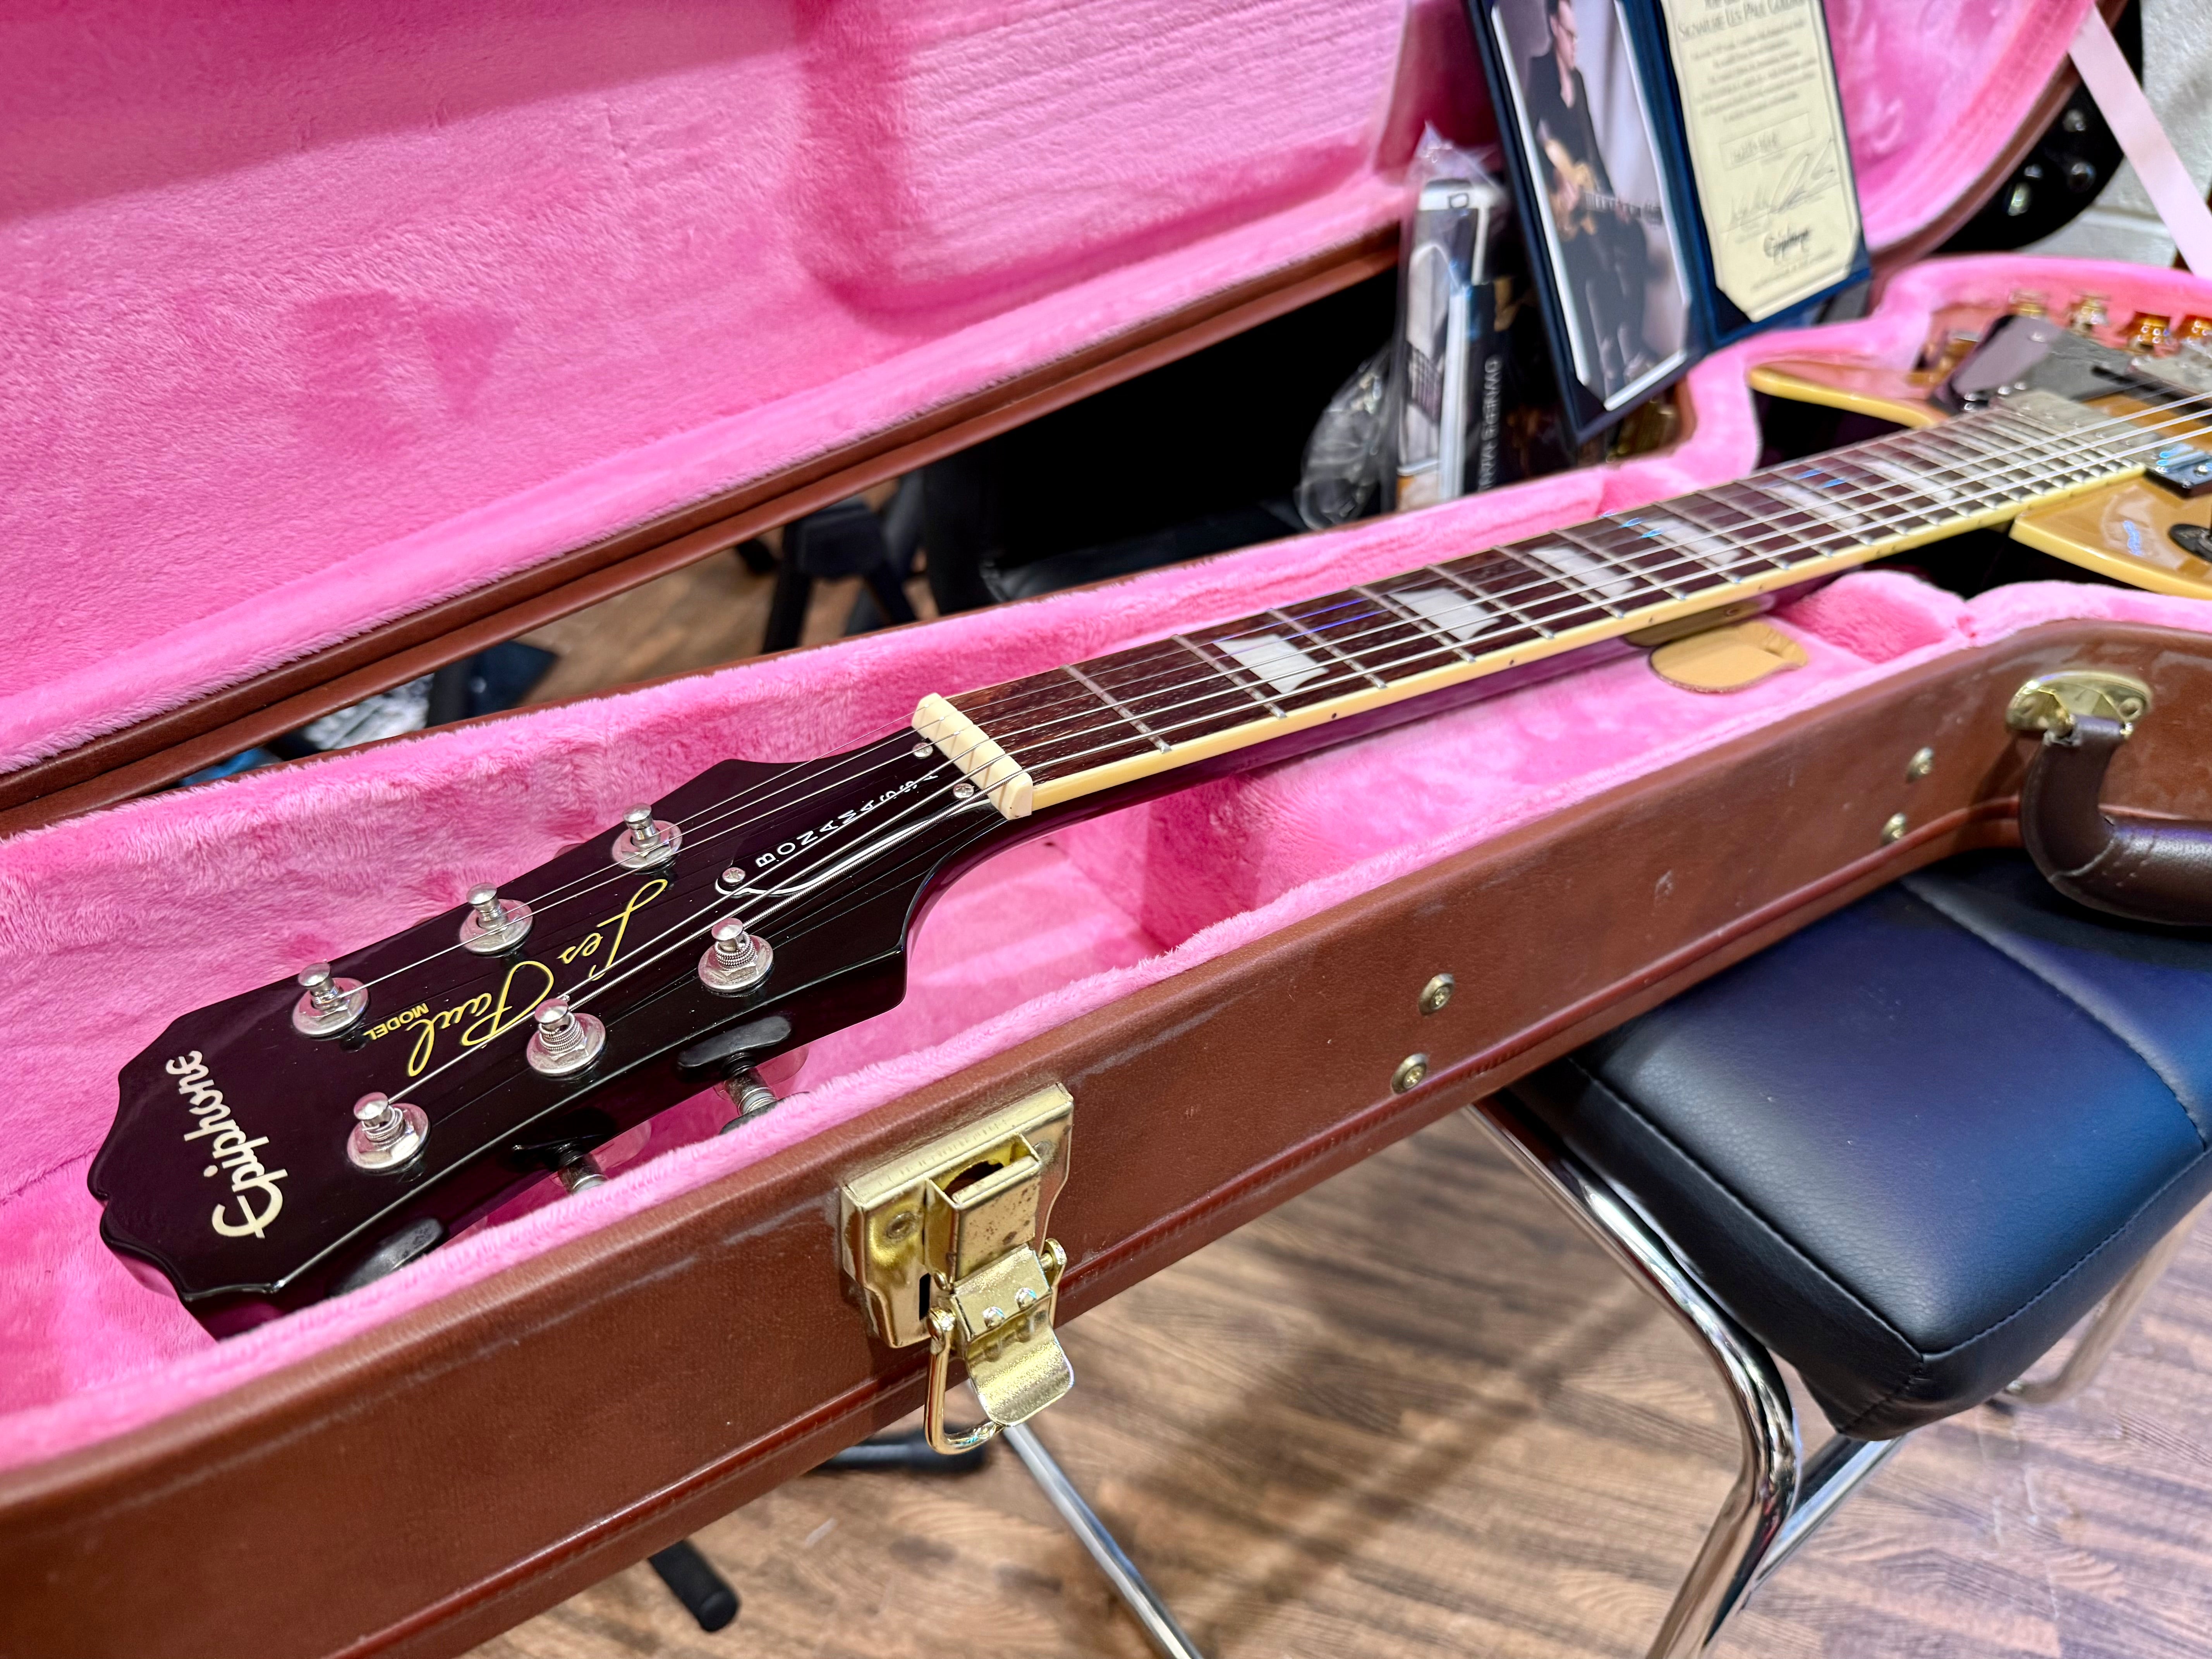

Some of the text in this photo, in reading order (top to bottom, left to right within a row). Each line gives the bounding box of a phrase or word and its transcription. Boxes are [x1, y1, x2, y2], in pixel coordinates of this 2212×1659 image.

[756, 771, 938, 867] BONAMASSA
[363, 1002, 429, 1041] MODEL
[407, 879, 668, 1077] Les Paul
[166, 1051, 288, 1238] Epiphone
